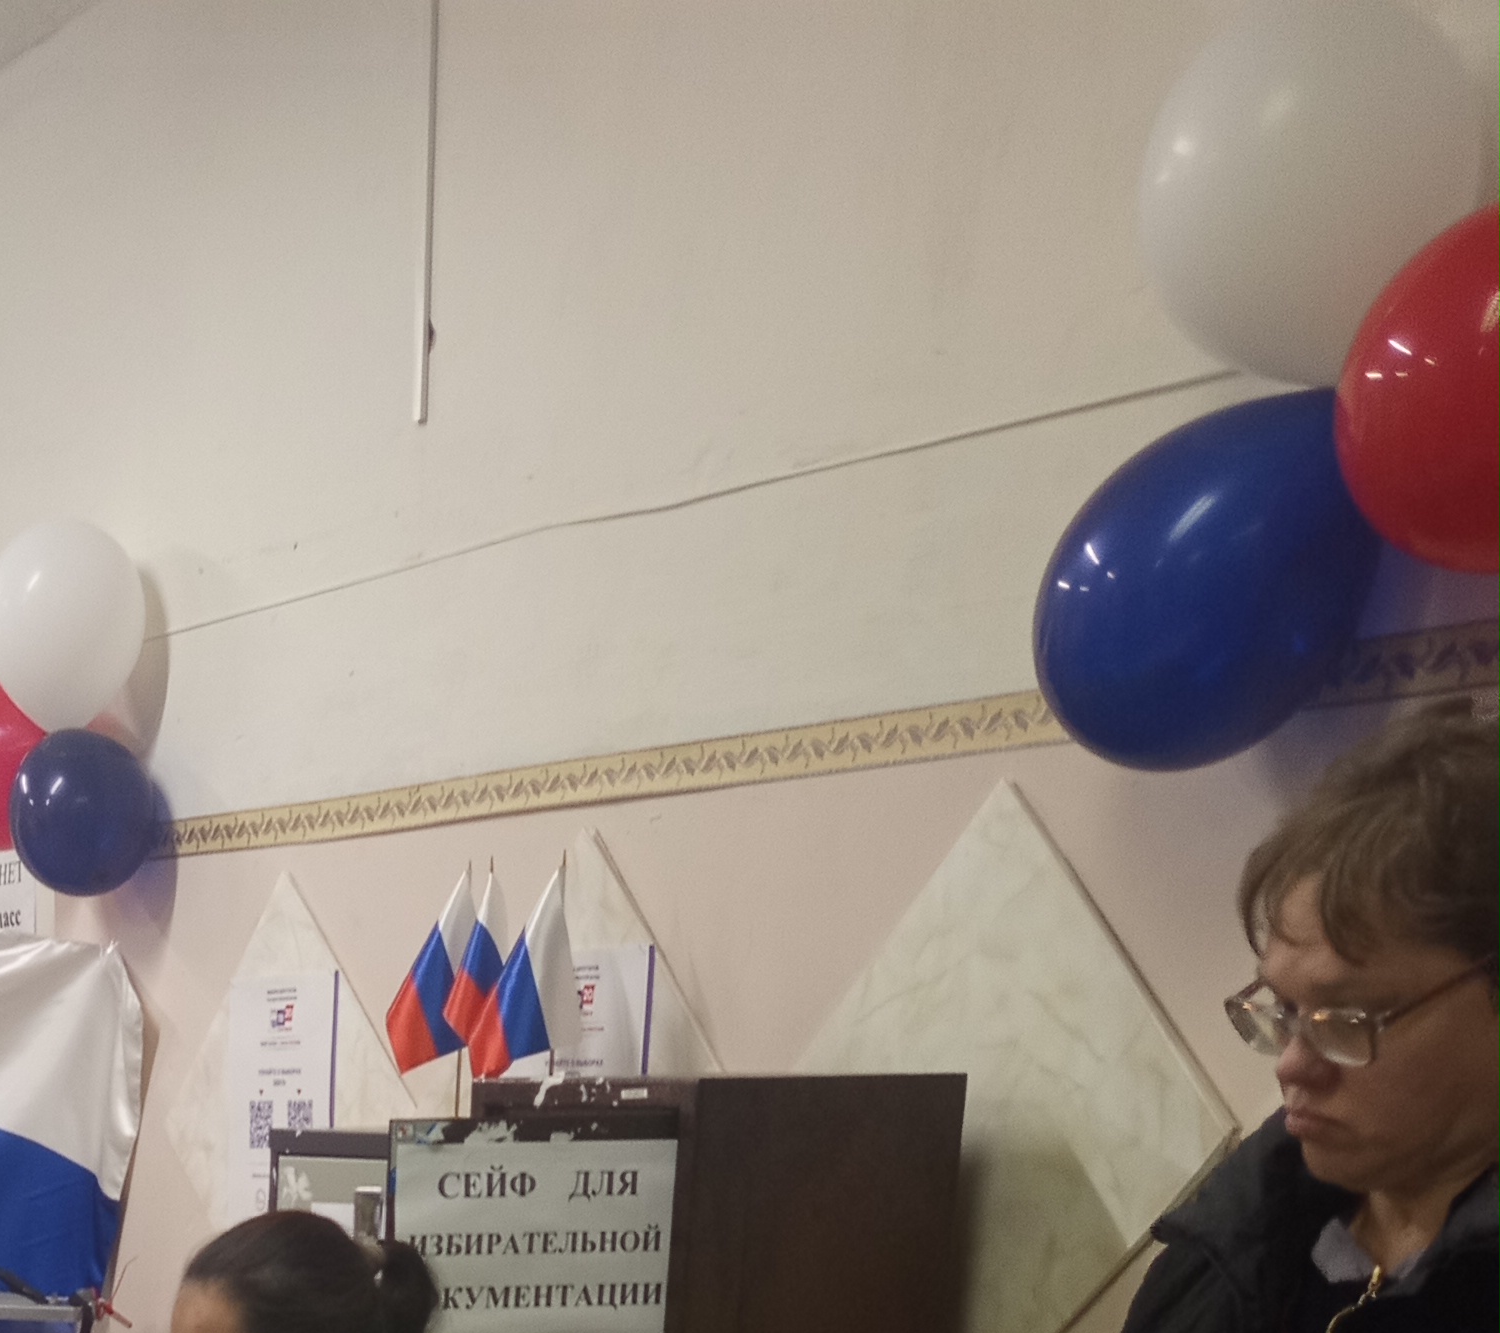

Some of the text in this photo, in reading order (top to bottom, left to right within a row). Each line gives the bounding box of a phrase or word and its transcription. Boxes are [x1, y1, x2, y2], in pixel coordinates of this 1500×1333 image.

[437, 1164, 639, 1202] СЕЙФ ДЛЯ
[410, 1224, 662, 1257] ИЗБИРАТЕЛЬНОЙ
[442, 1282, 663, 1310] КУМЕНТАЦИИ
